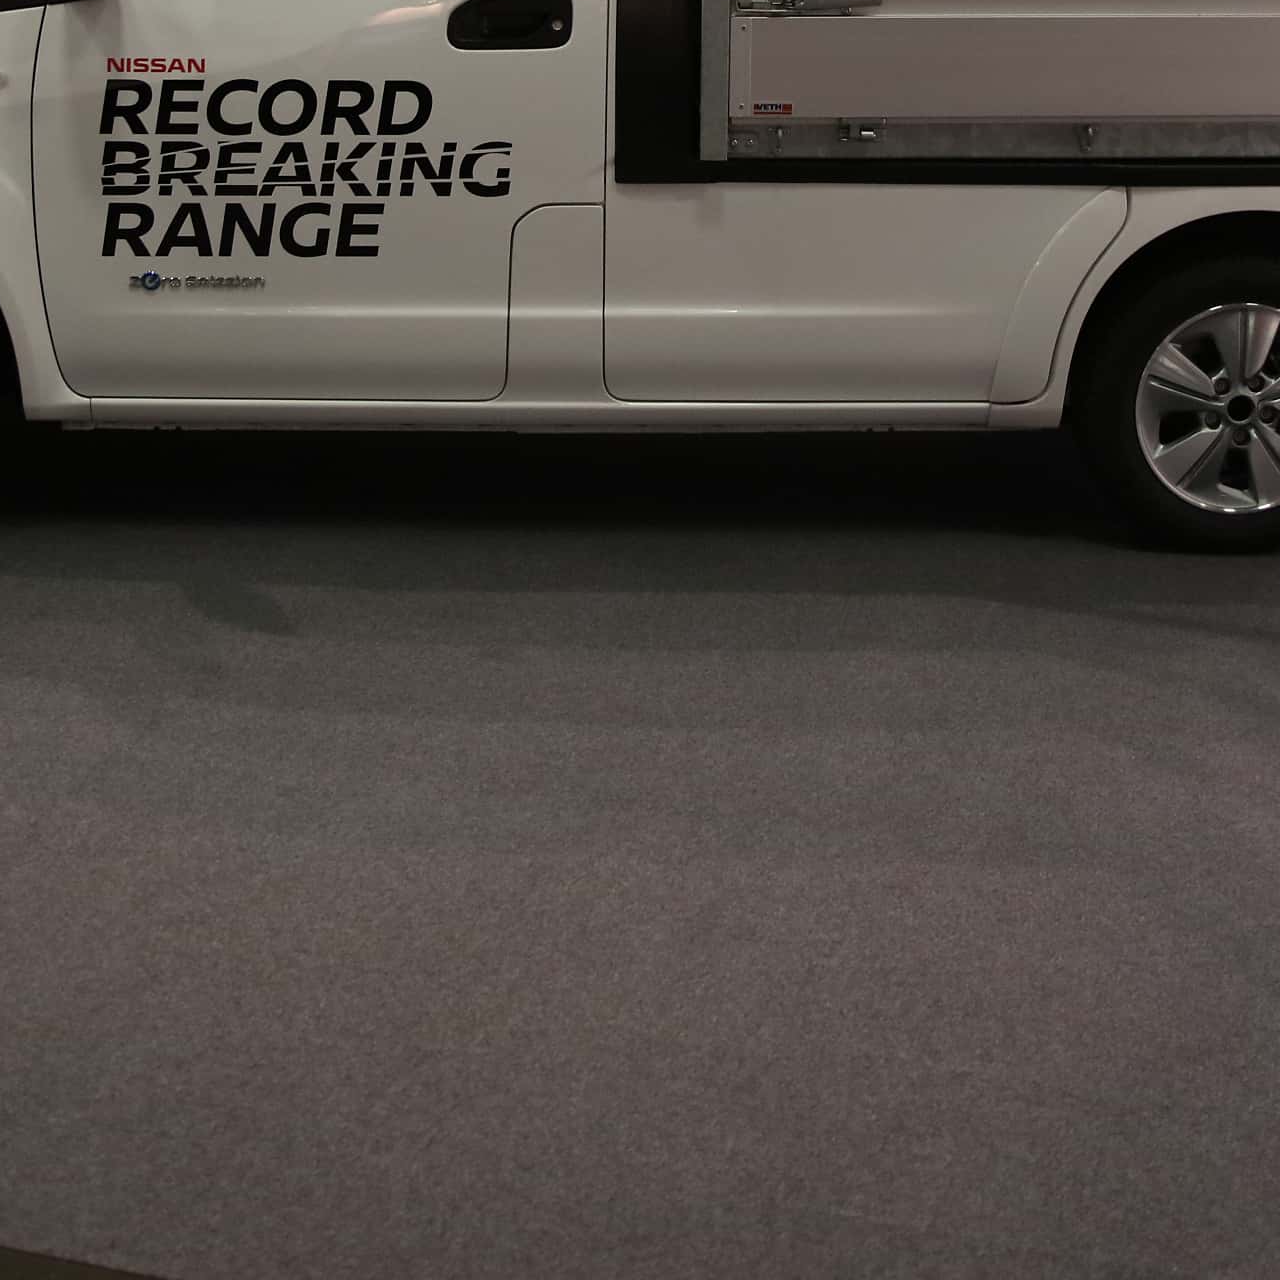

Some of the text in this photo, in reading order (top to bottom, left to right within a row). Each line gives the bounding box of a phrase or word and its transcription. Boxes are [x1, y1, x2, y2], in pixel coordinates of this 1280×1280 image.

[106, 57, 206, 74] NISSAN
[99, 78, 433, 137] RECORD
[101, 141, 513, 198] BREAKING
[101, 202, 385, 258] RANGE
